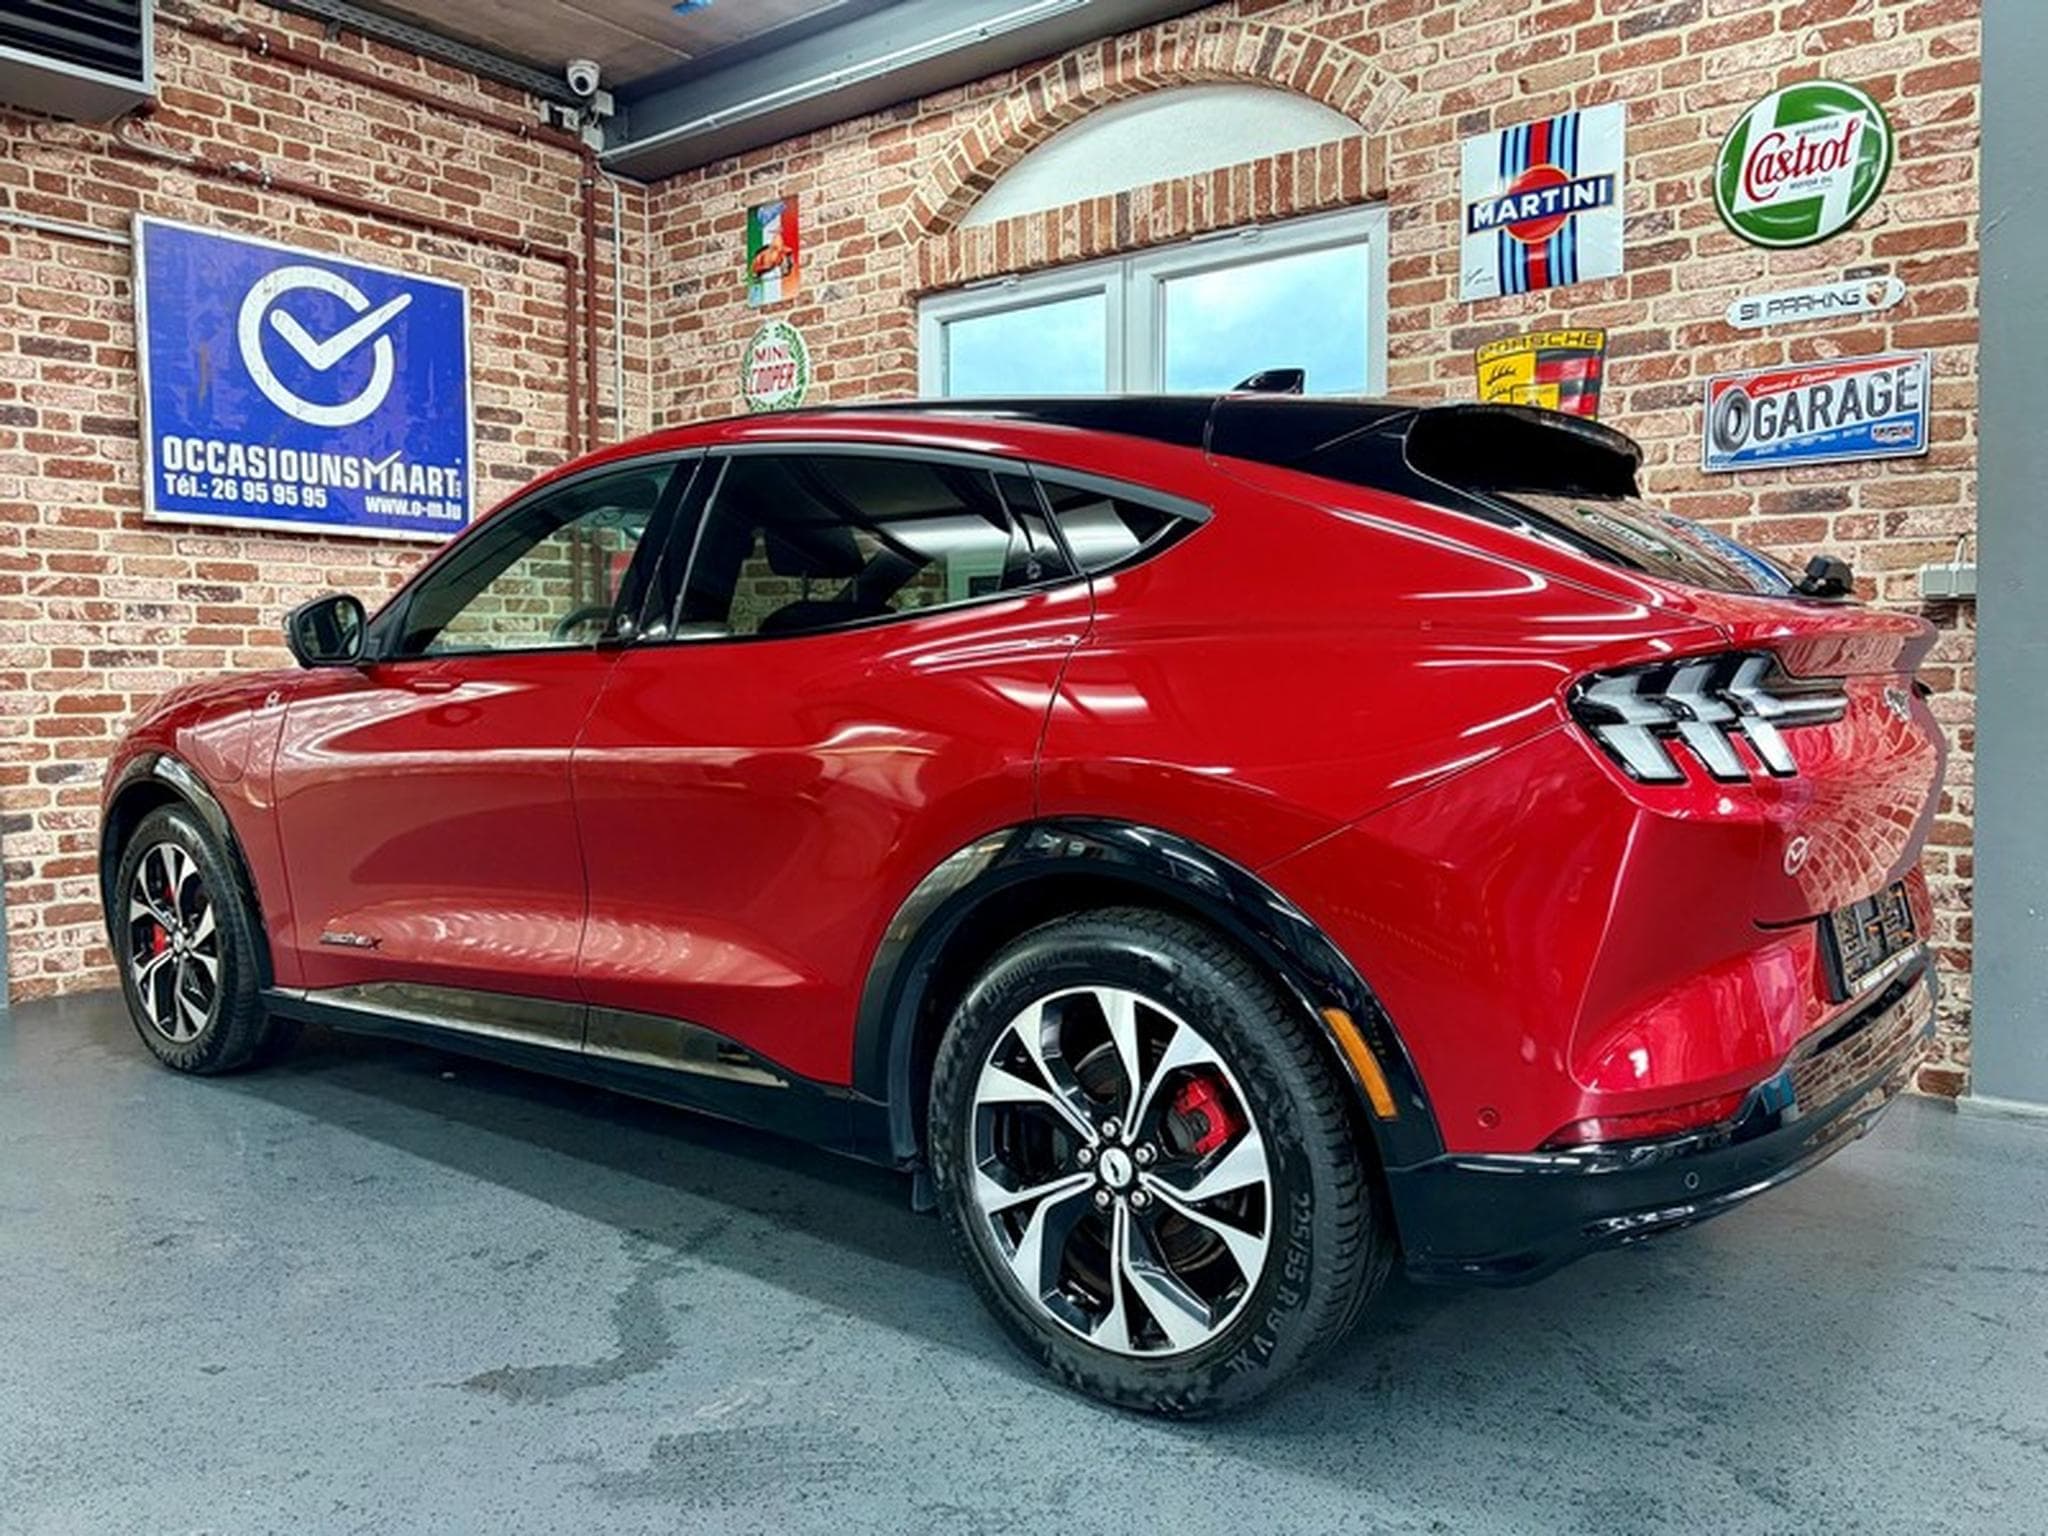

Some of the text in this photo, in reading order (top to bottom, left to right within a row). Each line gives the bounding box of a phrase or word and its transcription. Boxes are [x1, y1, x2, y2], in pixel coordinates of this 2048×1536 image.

[1745, 117, 1860, 203] Castrol
[1473, 179, 1607, 229] MARTINI
[1767, 289, 1860, 316] PARKING
[755, 345, 788, 363] MINI
[1479, 332, 1599, 360] PORSCHE
[749, 363, 795, 395] COOPER
[1754, 364, 1920, 441] GARAGE
[163, 473, 328, 509] Tél.: 26 95 95 95
[365, 495, 462, 521] www.o-m.lu
[1285, 1192, 1313, 1283] 225/55
[1277, 1284, 1300, 1308] R
[1252, 1333, 1275, 1356] V
